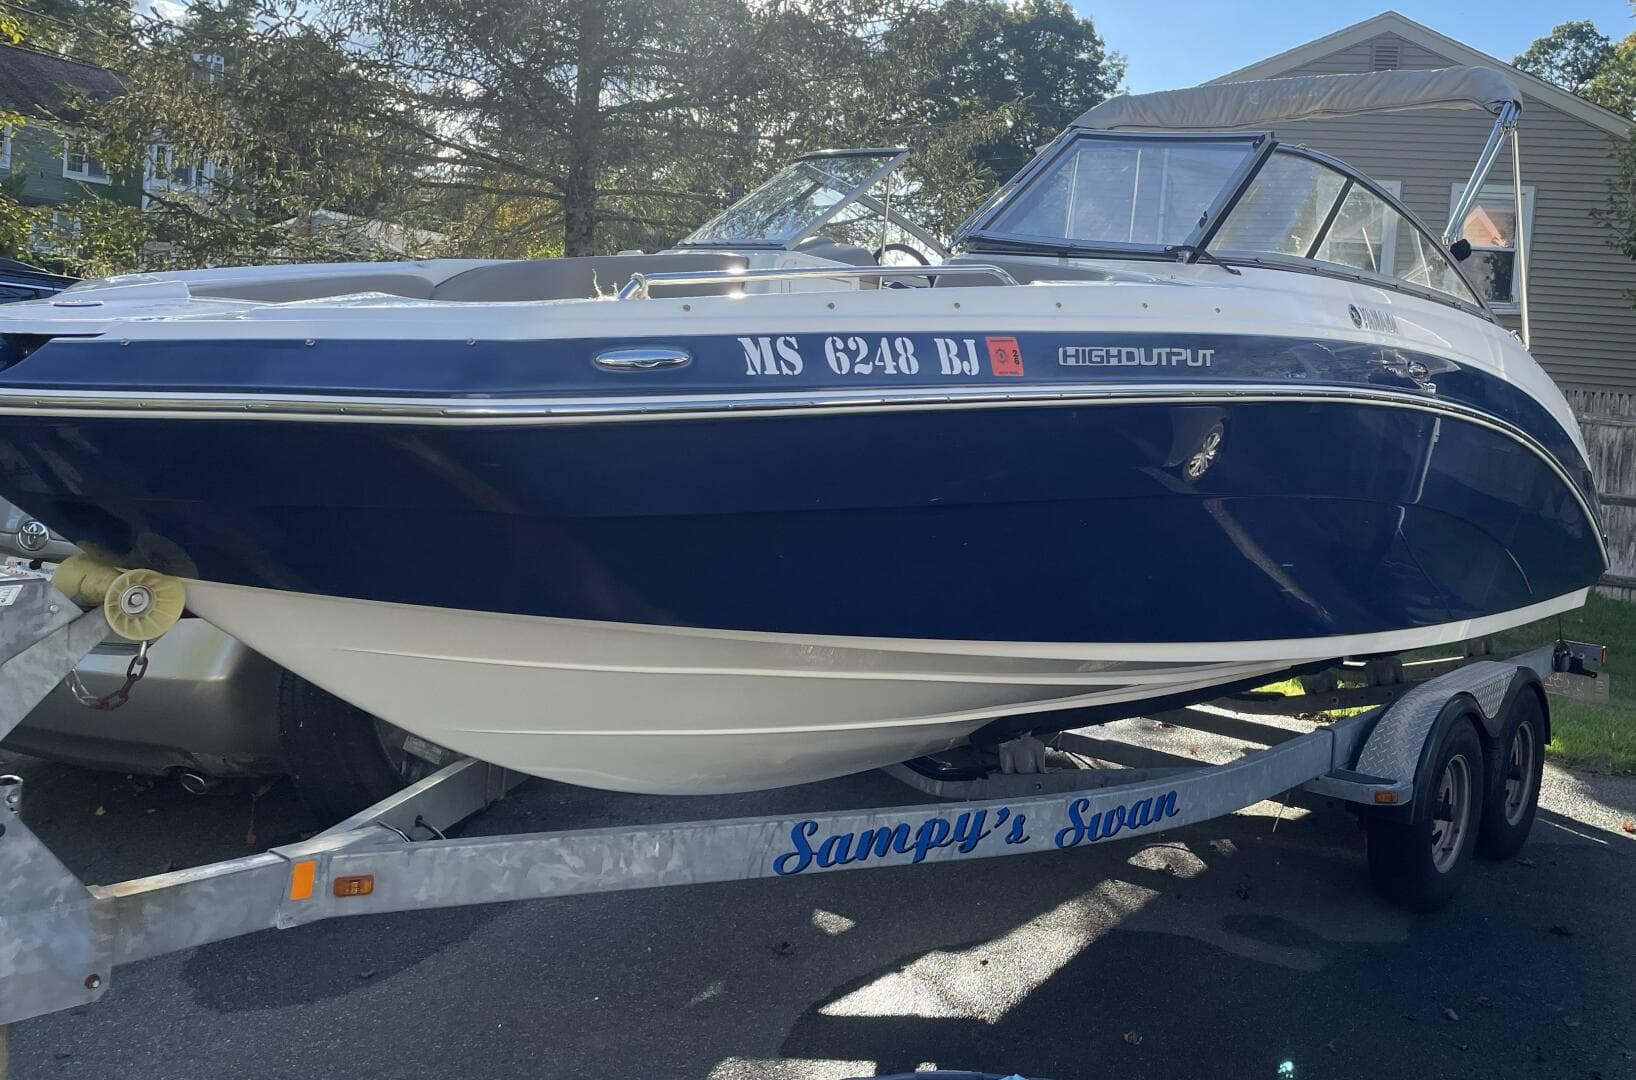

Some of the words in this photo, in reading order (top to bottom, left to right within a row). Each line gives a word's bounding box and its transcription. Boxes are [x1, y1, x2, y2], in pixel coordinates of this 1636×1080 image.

[737, 336, 803, 375] MS
[824, 336, 919, 375] 6248
[934, 338, 980, 375] BJ
[773, 806, 1030, 876] Sampy's
[1055, 790, 1180, 849] Swan
